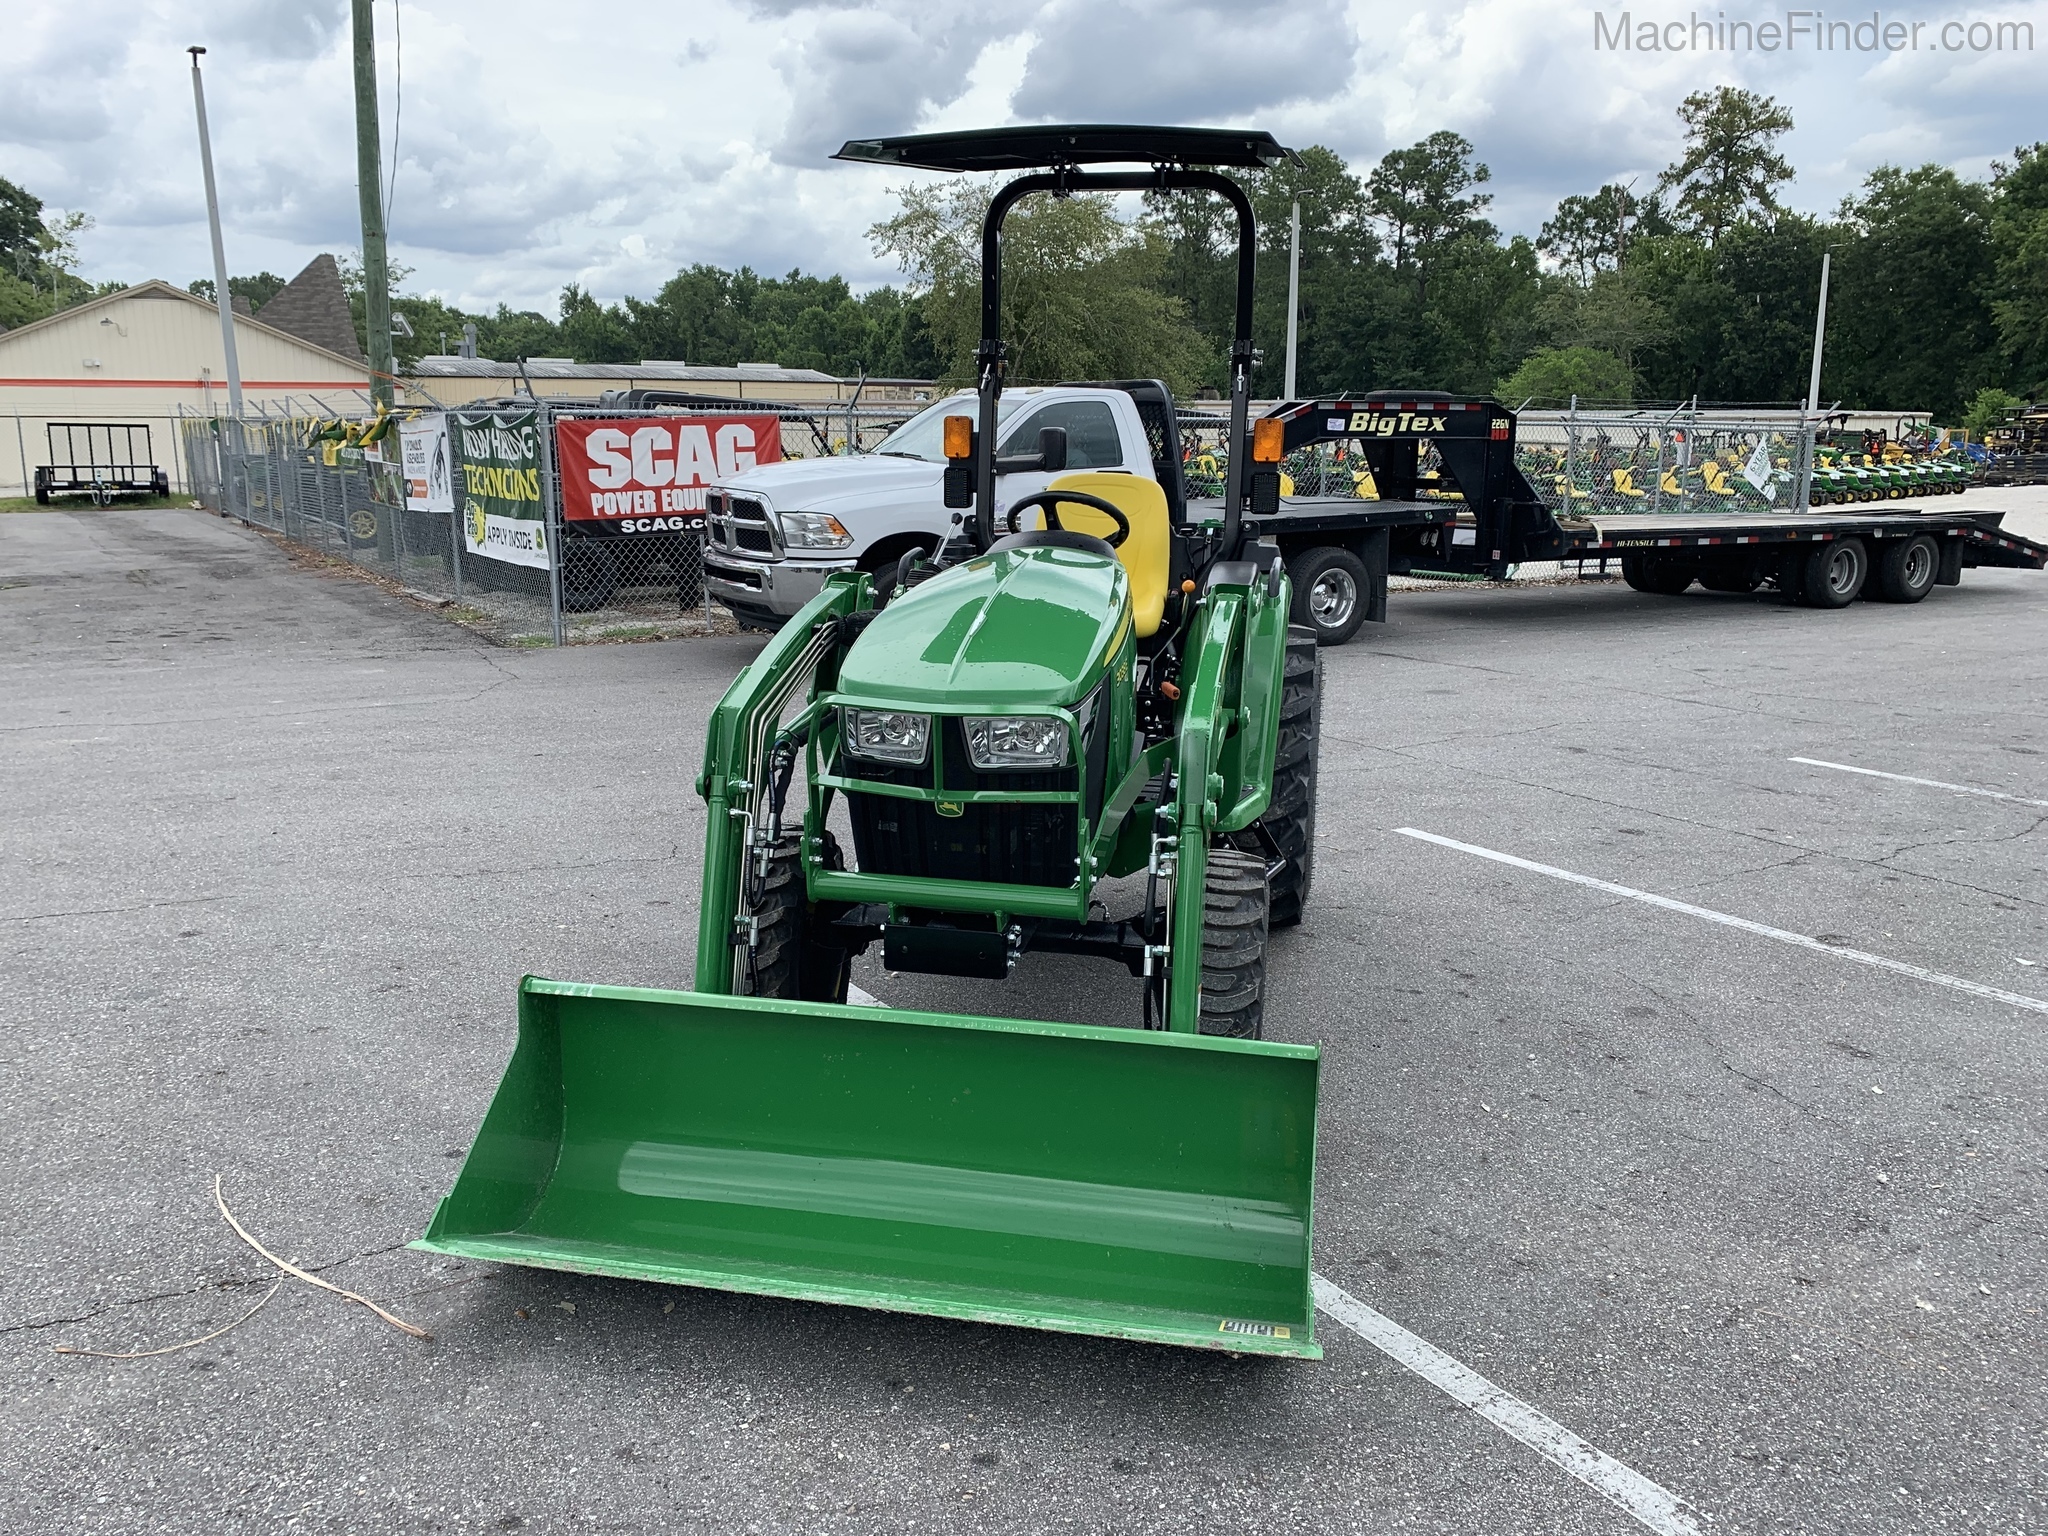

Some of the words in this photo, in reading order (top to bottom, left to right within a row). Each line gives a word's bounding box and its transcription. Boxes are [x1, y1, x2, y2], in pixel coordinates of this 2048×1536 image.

[1348, 412, 1448, 437] BigTex
[1491, 429, 1509, 440] HD
[585, 423, 757, 489] SCAG
[463, 464, 540, 501] TECHNICIANS
[590, 489, 657, 516] POWER
[487, 525, 508, 546] APPLY
[508, 529, 533, 550] INSIDE
[1616, 539, 1655, 548] HI-TENSILE
